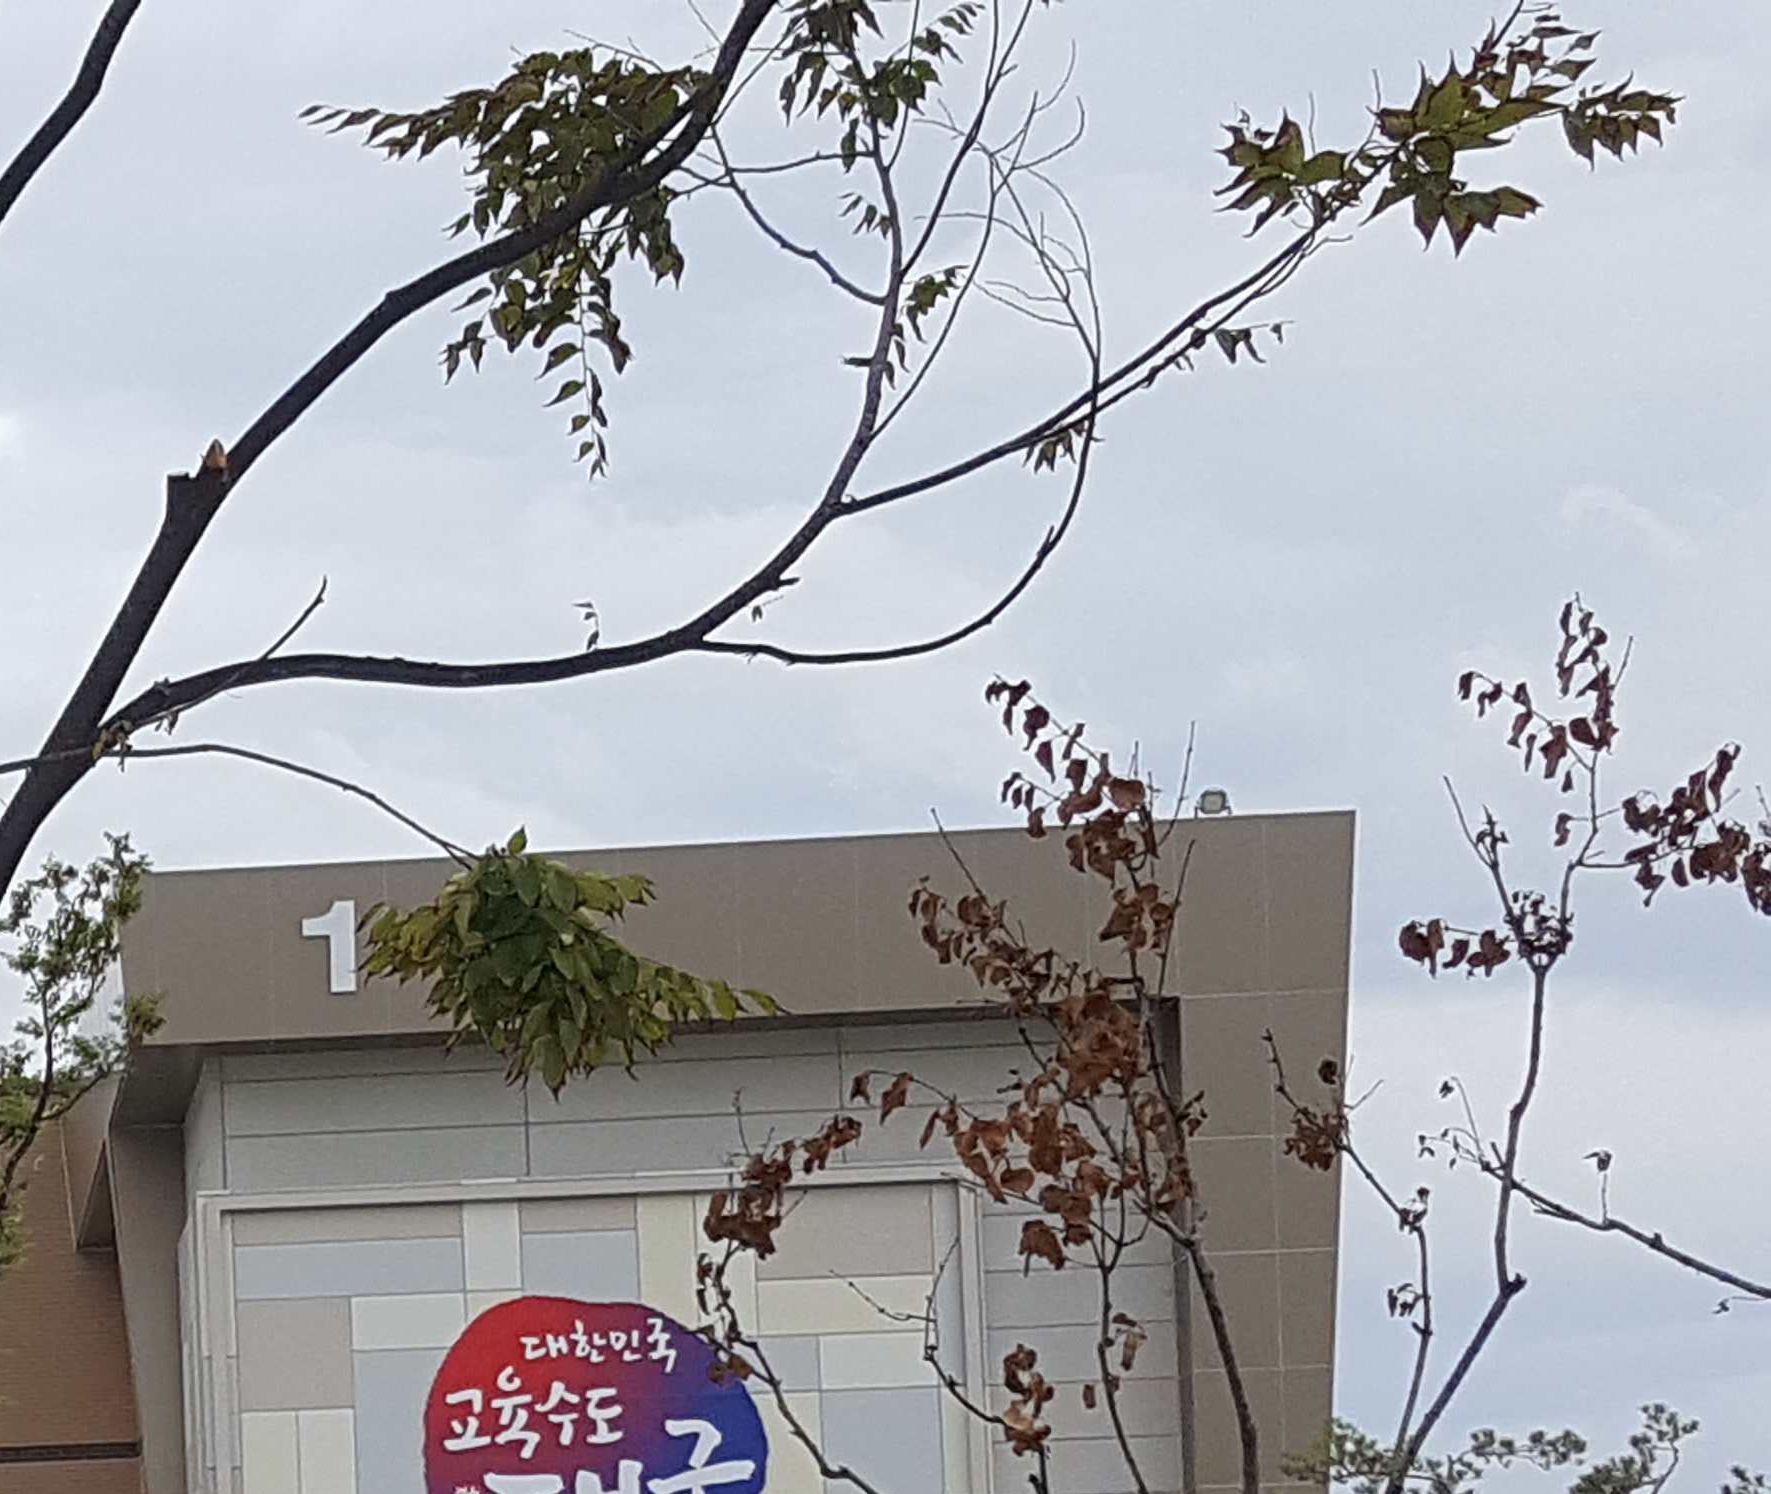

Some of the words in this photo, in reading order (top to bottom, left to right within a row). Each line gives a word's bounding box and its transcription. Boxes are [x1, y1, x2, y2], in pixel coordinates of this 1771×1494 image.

[302, 900, 357, 993] 1
[520, 1317, 678, 1373] 대한민국
[443, 1366, 624, 1458] 교육수도
